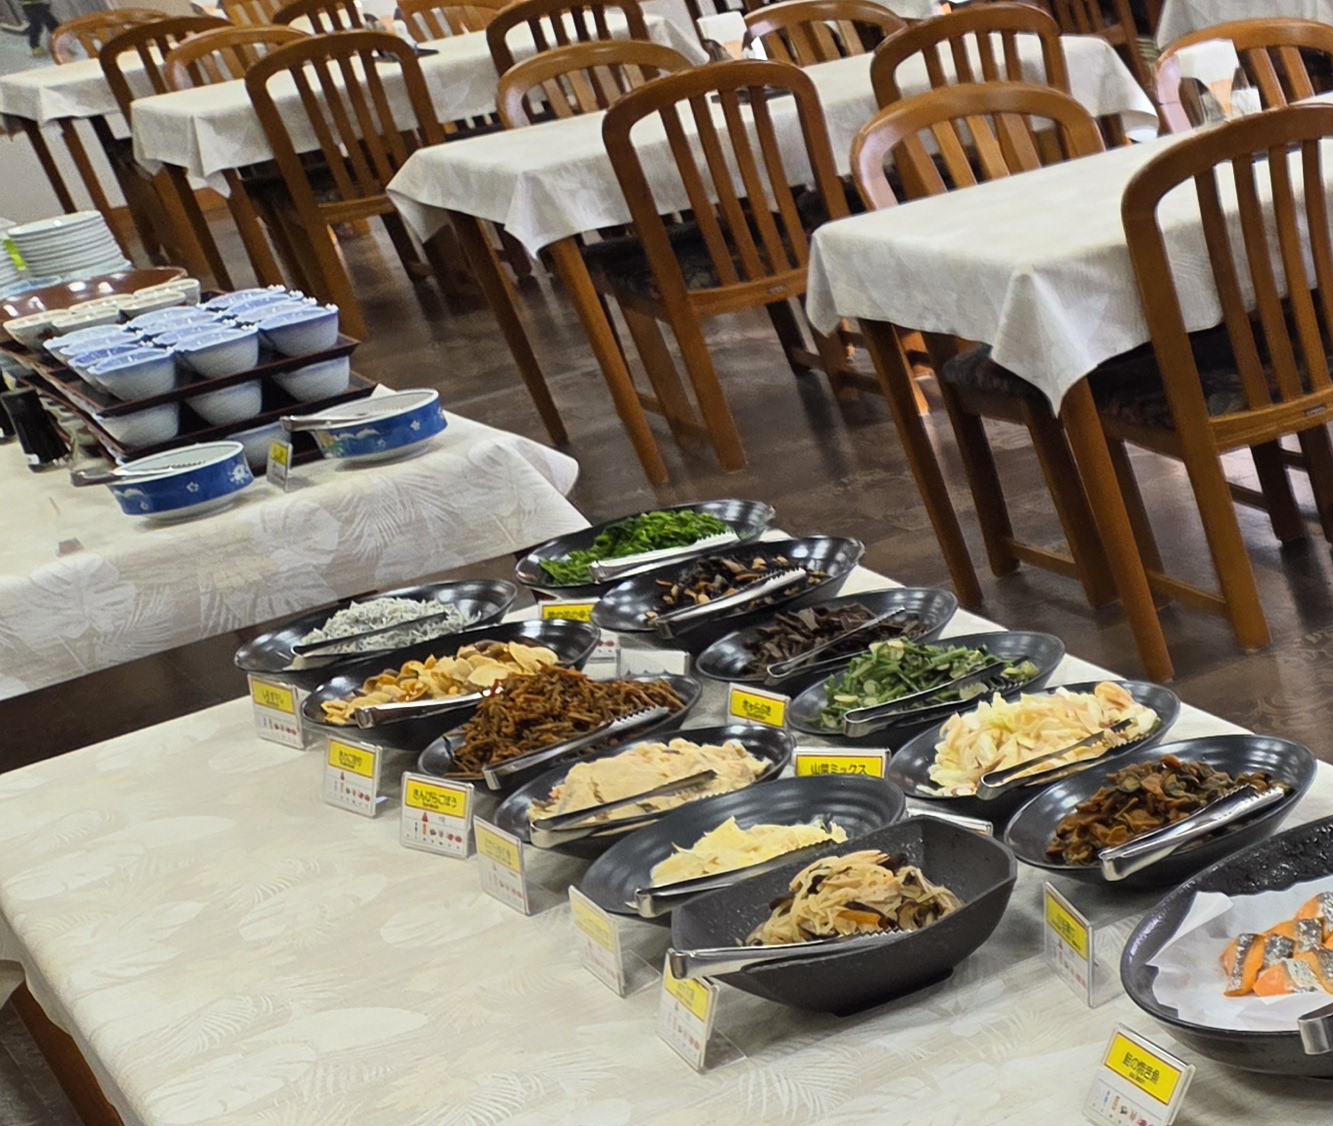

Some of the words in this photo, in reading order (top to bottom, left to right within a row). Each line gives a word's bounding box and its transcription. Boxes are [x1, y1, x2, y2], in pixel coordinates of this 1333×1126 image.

[413, 788, 457, 808] きんぴらごぼう
